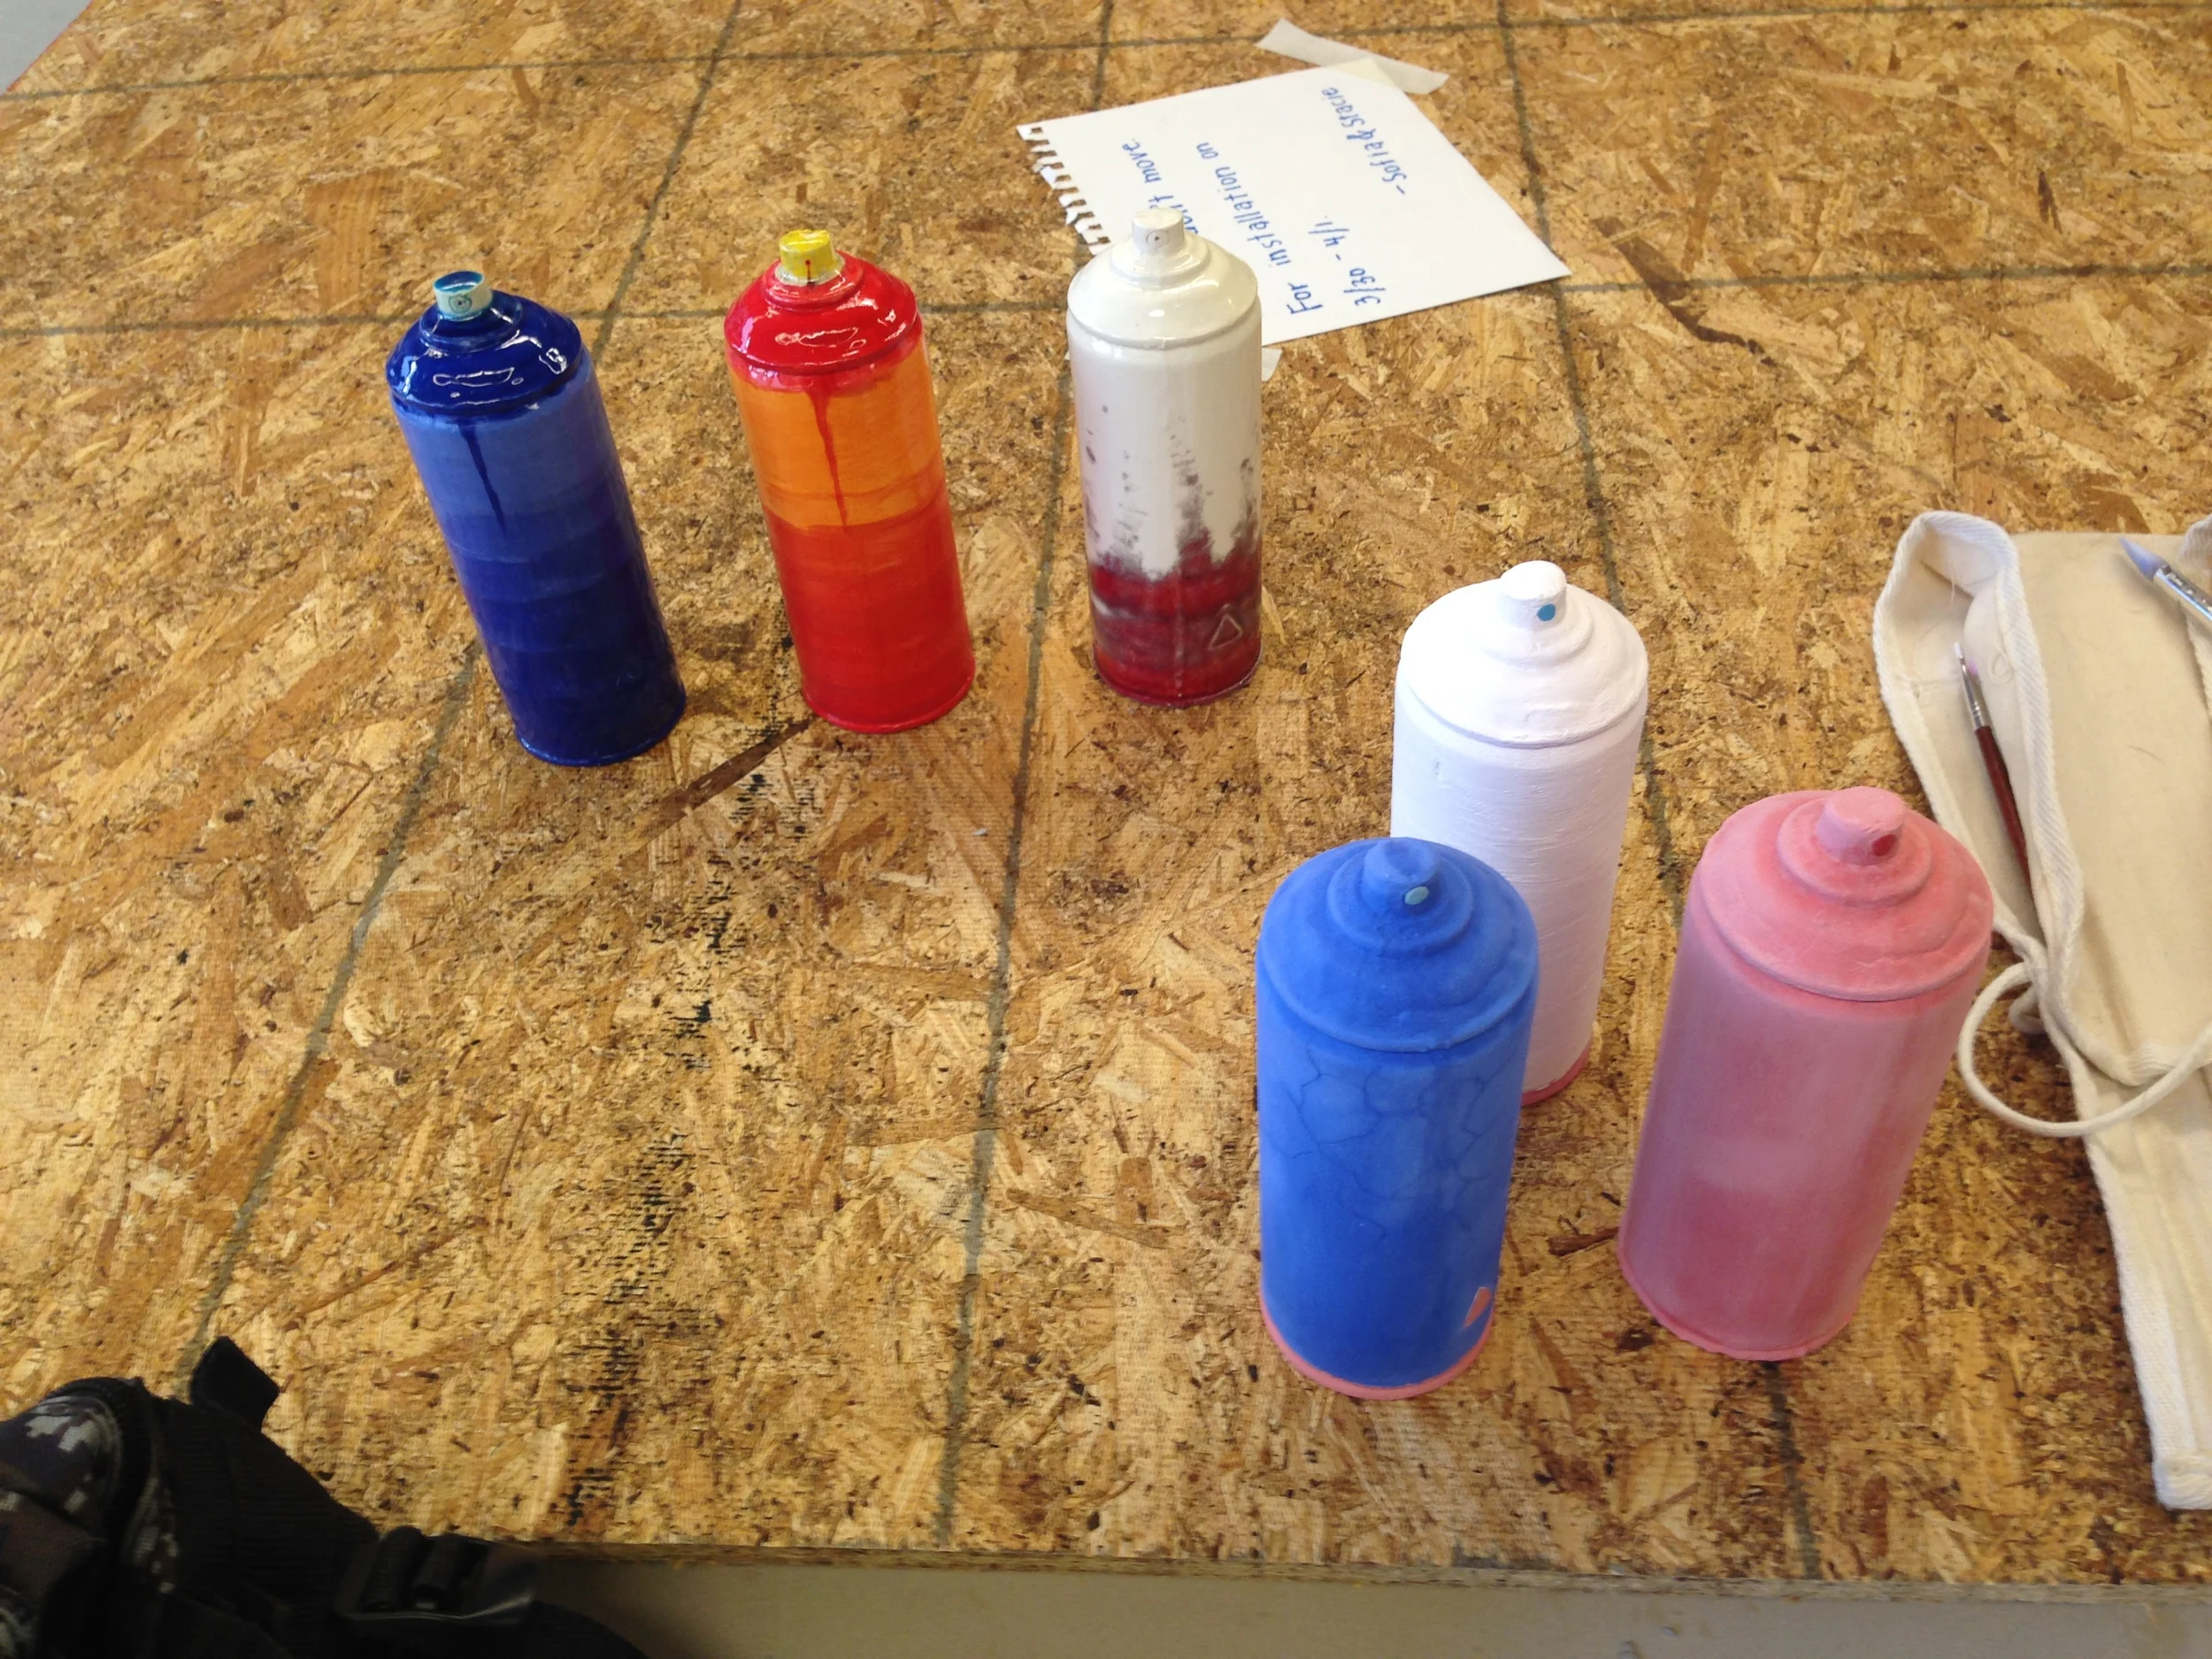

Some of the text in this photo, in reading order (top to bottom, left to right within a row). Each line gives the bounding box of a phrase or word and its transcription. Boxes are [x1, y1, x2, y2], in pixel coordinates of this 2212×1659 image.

[1321, 87, 1365, 127] Stacie
[1195, 142, 1324, 314] For installation on
[1343, 267, 1386, 306] 3/30
